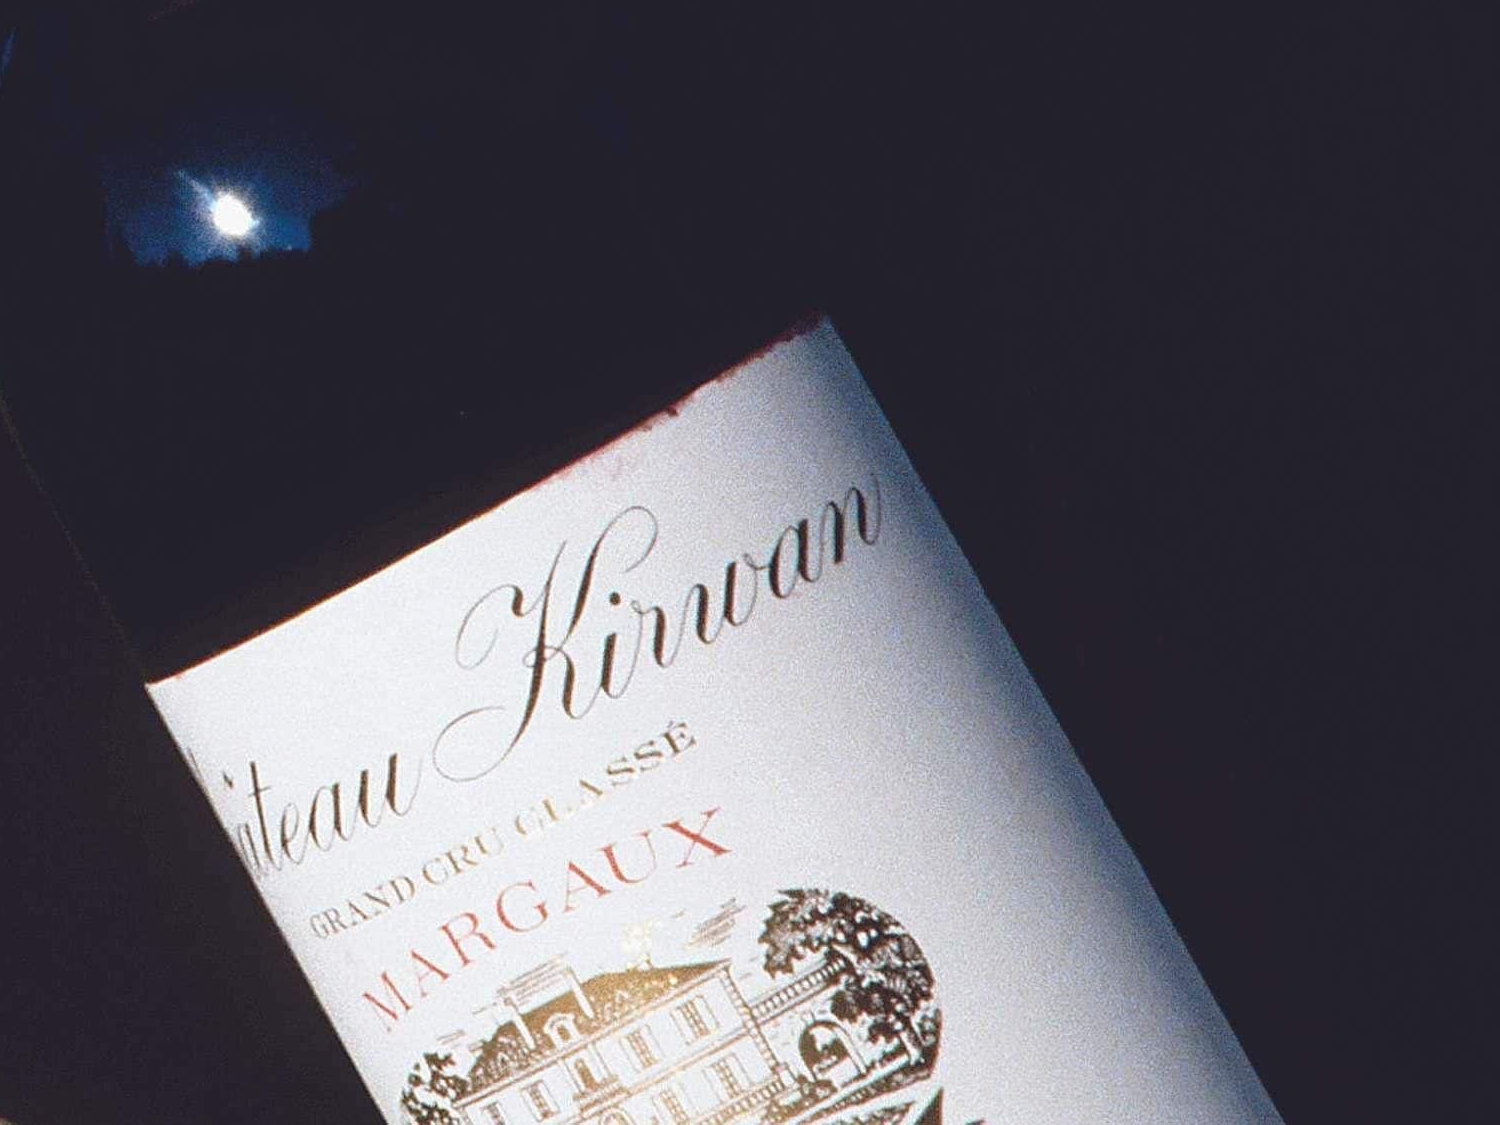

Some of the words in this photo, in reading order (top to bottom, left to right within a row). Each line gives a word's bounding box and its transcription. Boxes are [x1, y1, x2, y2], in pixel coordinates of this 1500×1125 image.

[432, 473, 882, 783] Kirwan
[309, 875, 415, 939] GRAND
[422, 826, 506, 886] CRU
[514, 720, 697, 836] CLASSÉ
[362, 806, 733, 1033] MARGAUX
